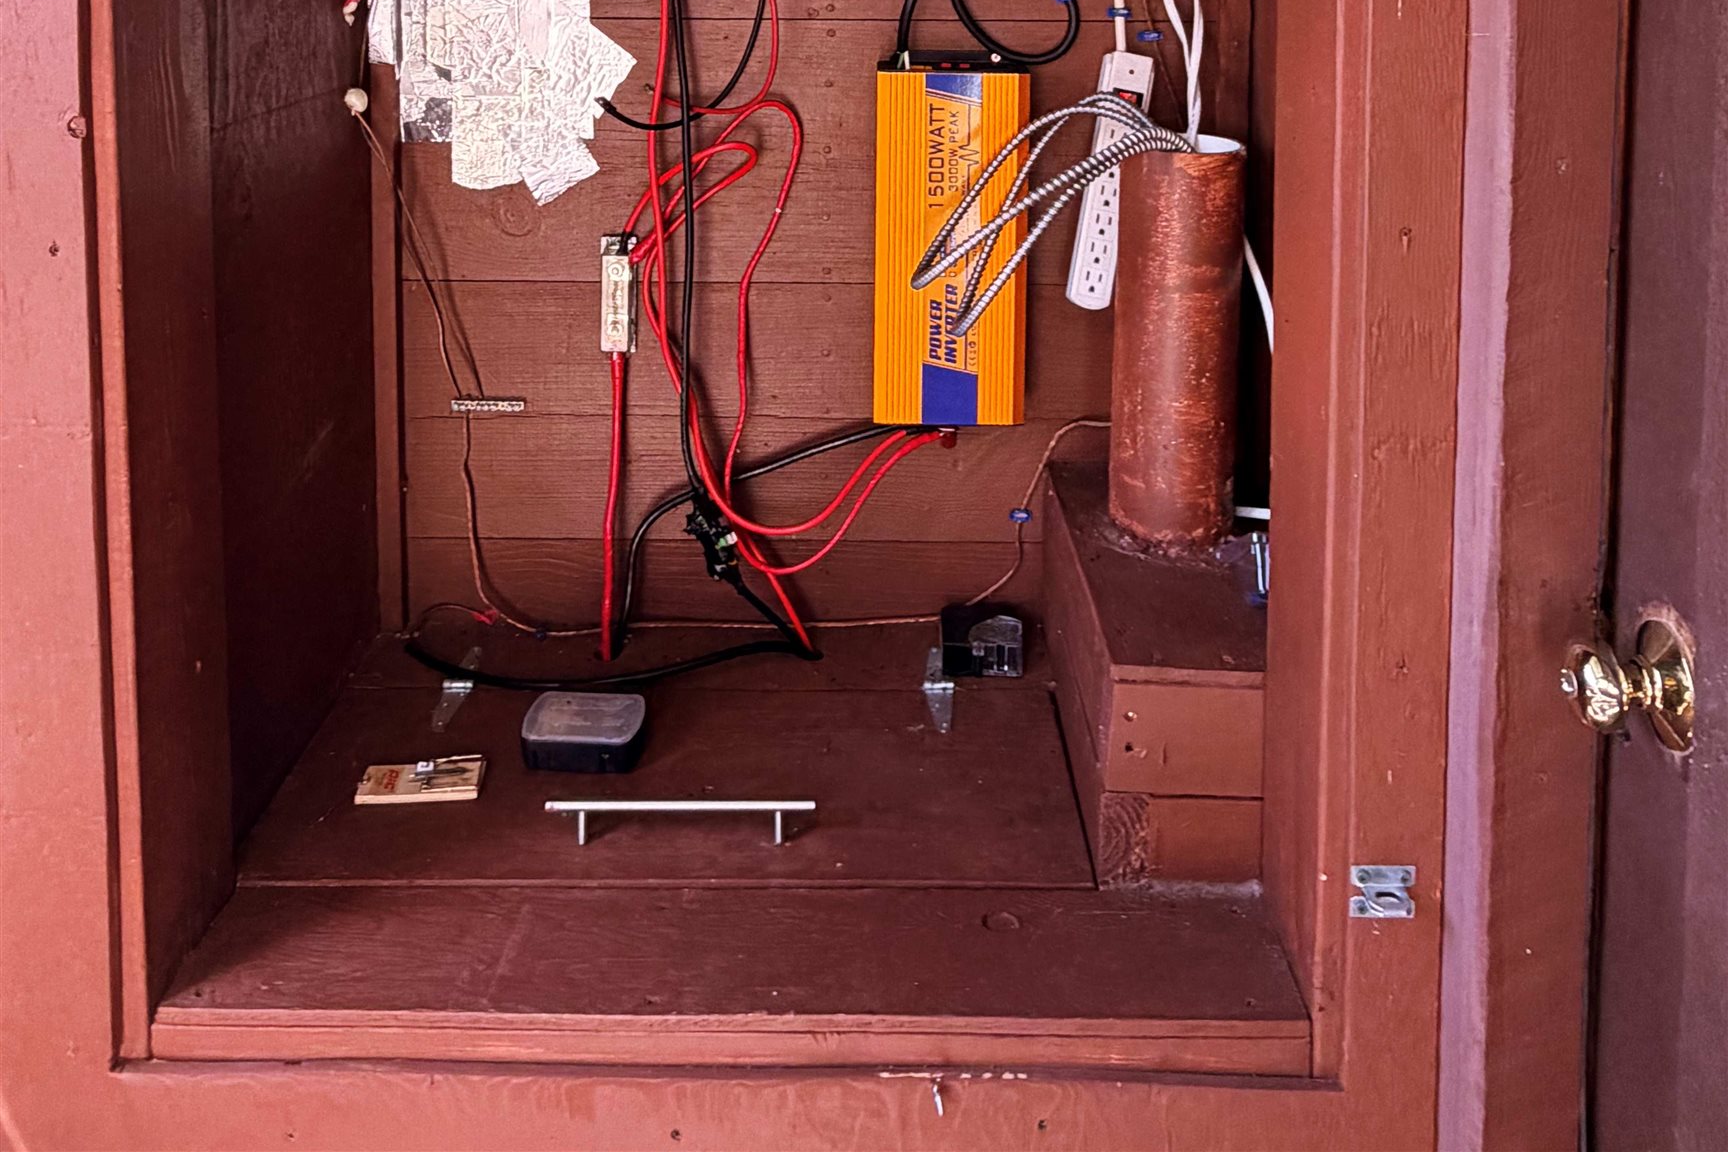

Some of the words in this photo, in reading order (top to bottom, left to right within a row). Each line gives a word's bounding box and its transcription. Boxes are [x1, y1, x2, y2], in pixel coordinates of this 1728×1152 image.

[948, 111, 960, 143] PEAK
[927, 103, 945, 209] 1500WATT
[947, 147, 959, 192] 3000W
[928, 299, 943, 361] POWER
